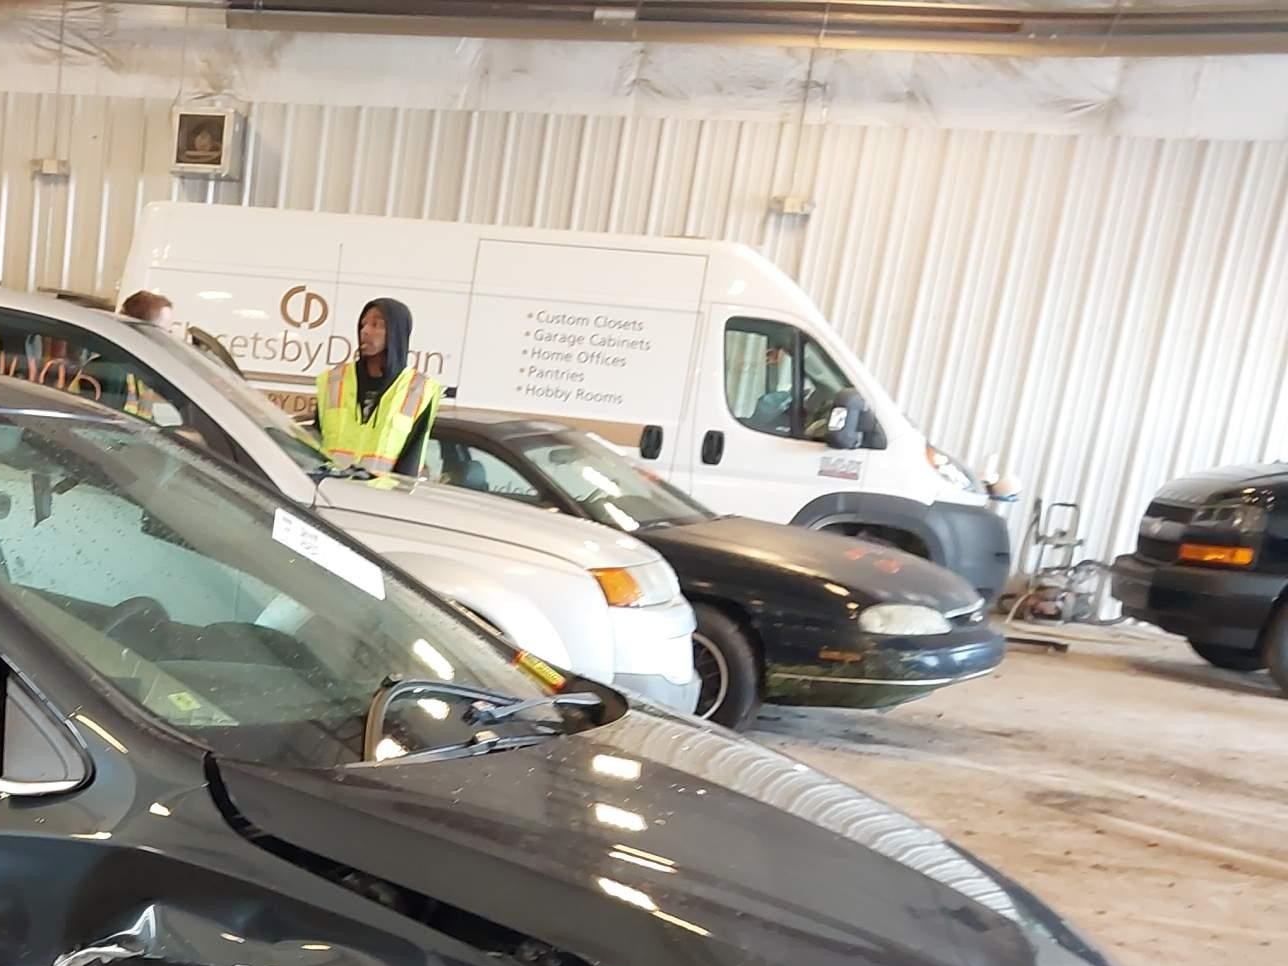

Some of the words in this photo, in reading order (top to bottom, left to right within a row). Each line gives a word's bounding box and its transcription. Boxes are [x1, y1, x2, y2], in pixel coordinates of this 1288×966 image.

[535, 310, 590, 327] Custom
[593, 315, 644, 332] Closets
[534, 328, 585, 347] Garage
[589, 333, 651, 351] Cabinets
[530, 347, 573, 362] Home
[576, 351, 627, 368] Offices
[527, 365, 585, 382] Pantries
[524, 384, 572, 402] Hobby
[575, 388, 624, 405] Rooms
